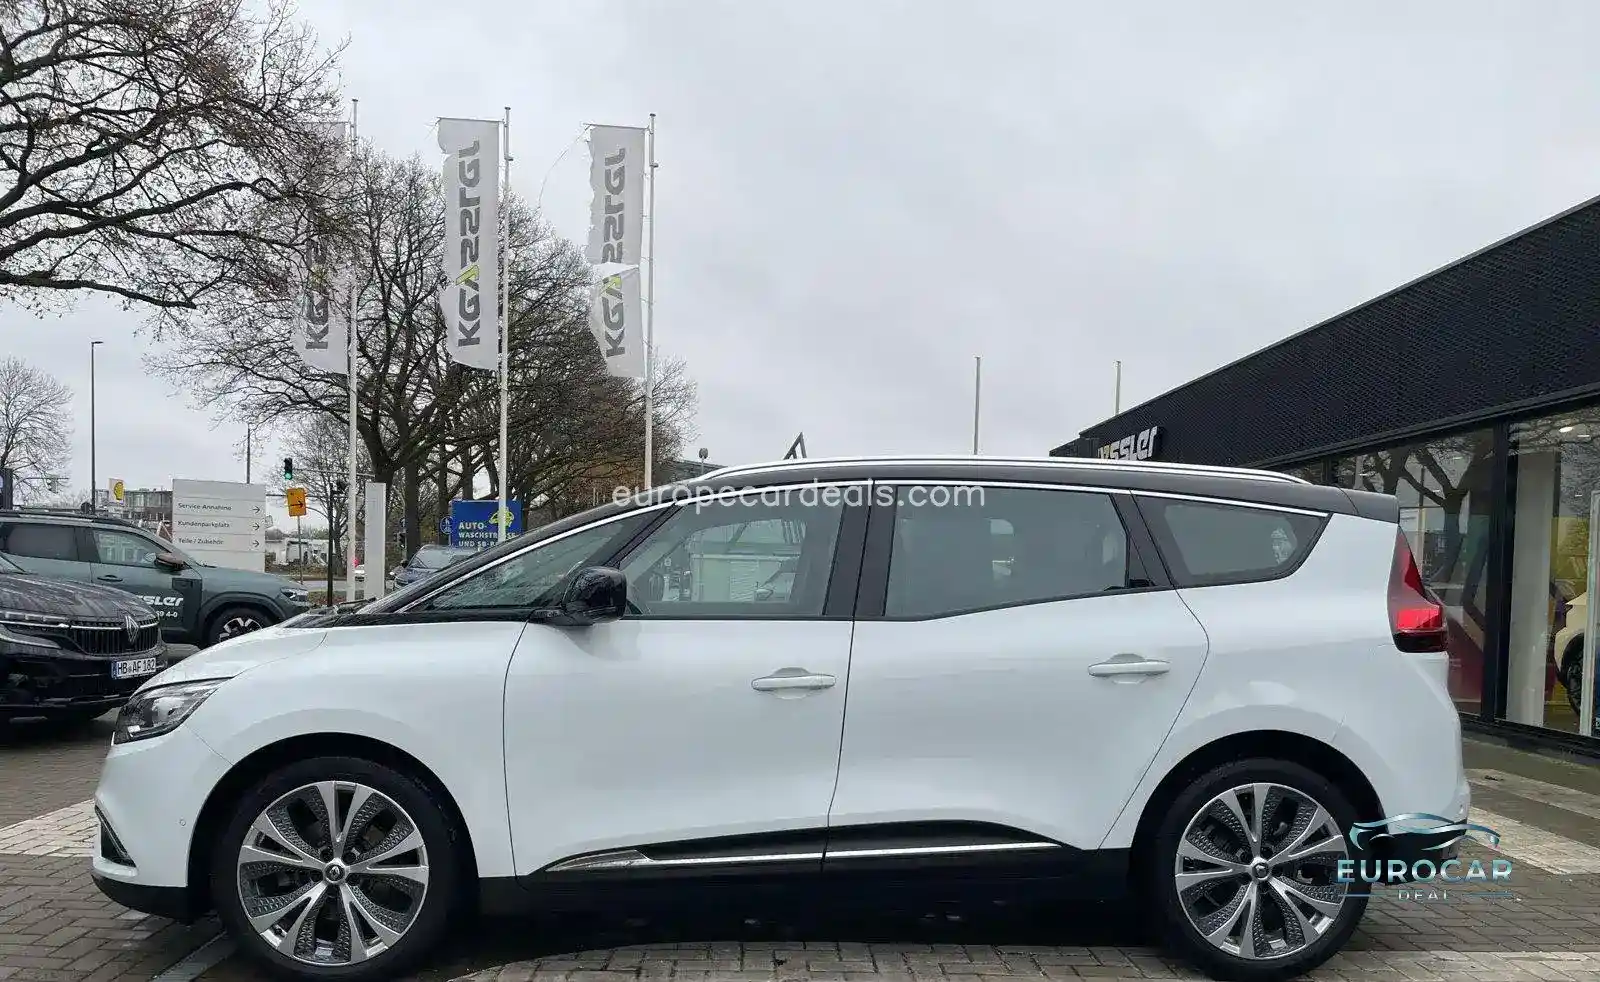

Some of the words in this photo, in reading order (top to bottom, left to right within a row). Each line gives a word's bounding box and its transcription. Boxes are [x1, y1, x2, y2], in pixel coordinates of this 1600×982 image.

[458, 521, 487, 530] AUTO-
[117, 662, 128, 675] HB
[132, 660, 142, 673] AF
